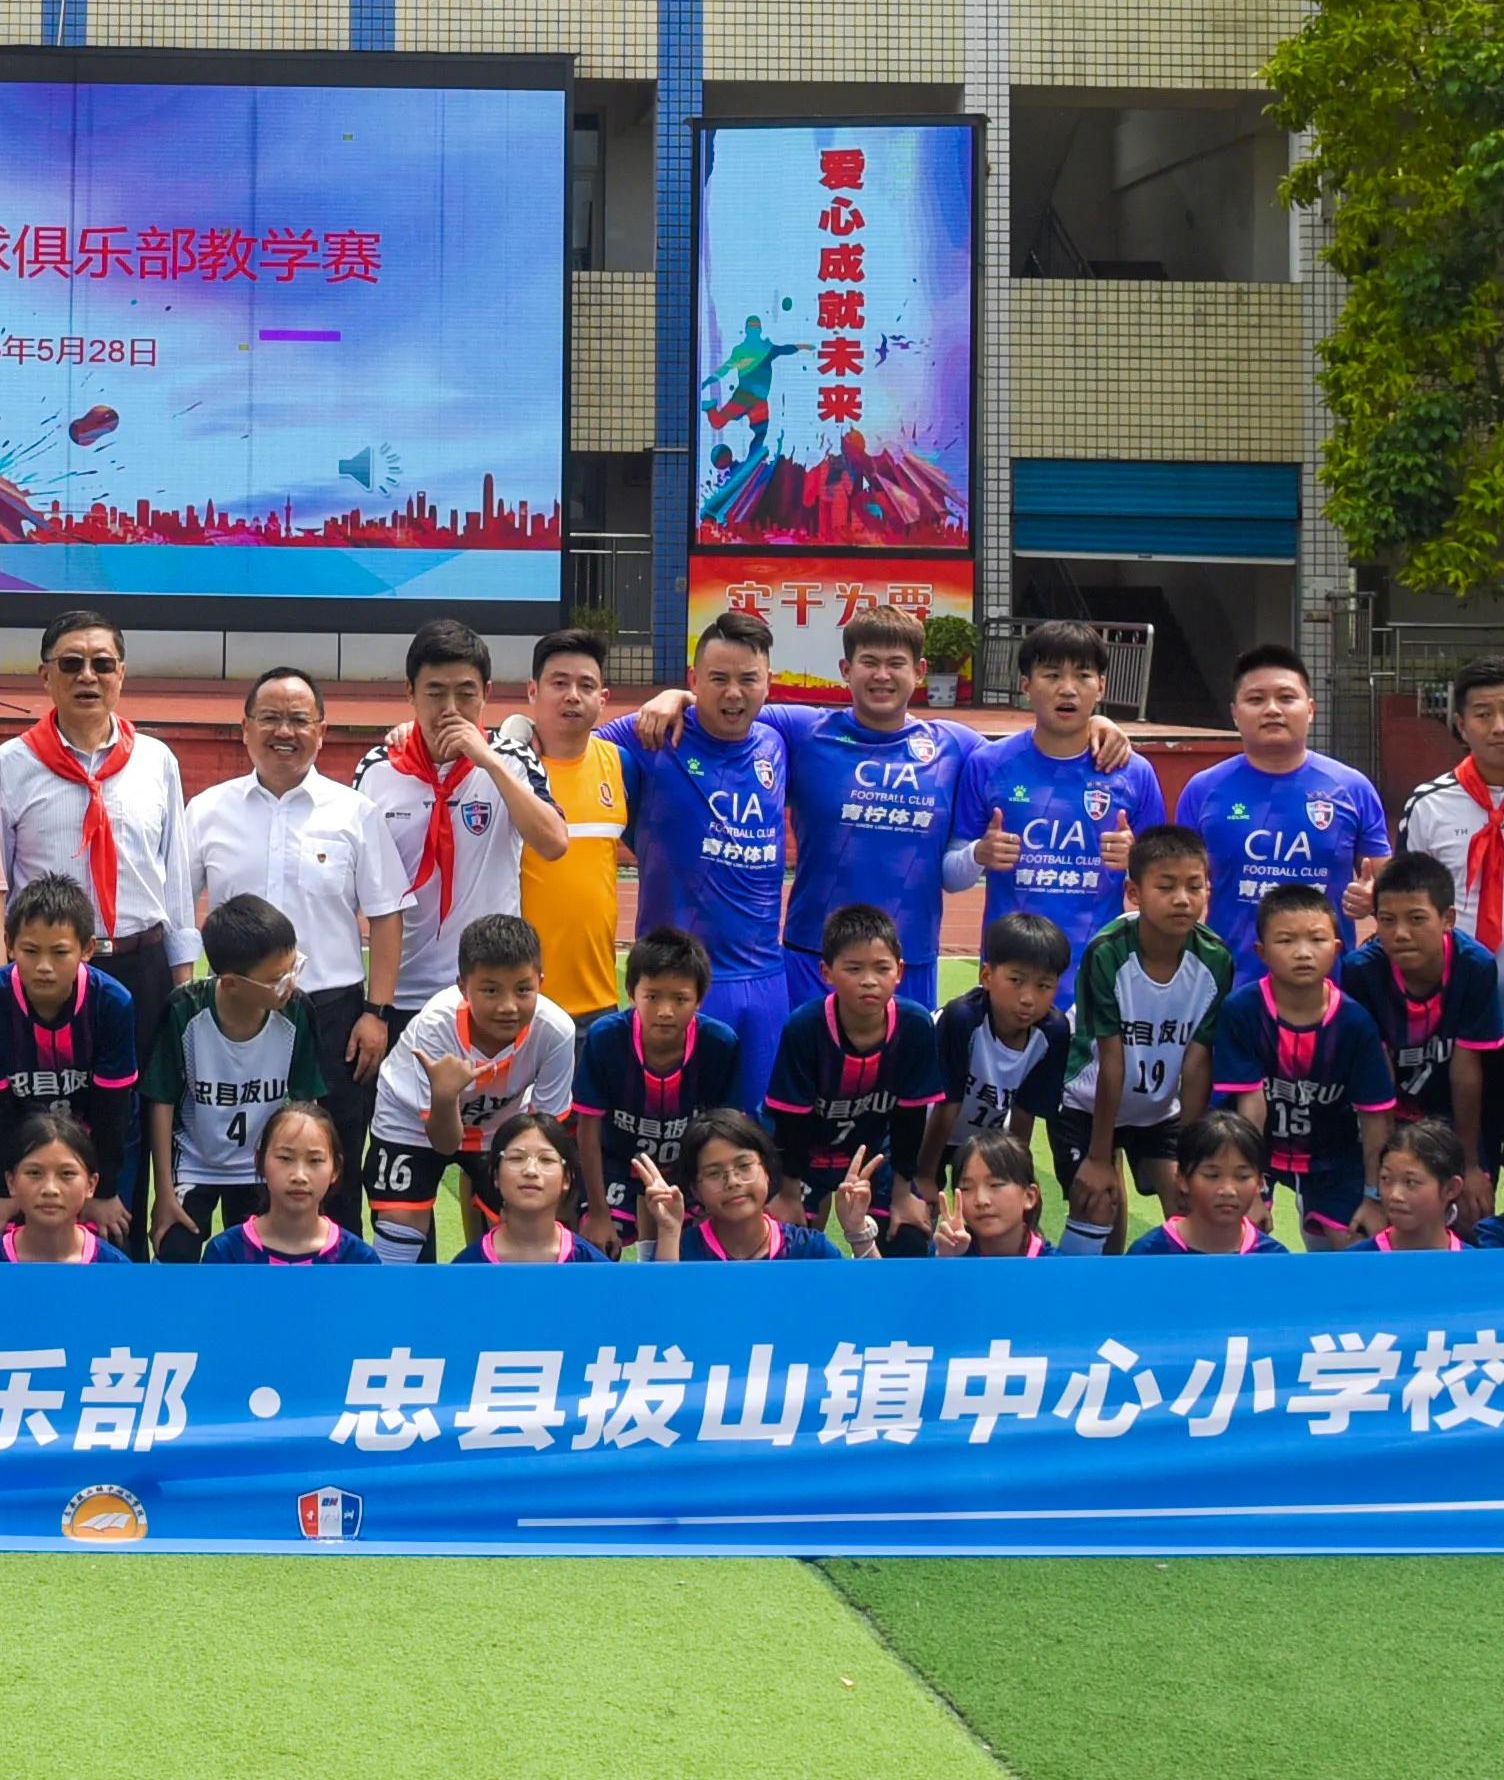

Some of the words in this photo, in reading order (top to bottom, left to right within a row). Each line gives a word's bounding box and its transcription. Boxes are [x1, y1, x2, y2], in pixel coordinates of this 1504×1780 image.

[817, 147, 866, 424] 爱心成就未来
[854, 761, 919, 790] CIA
[708, 790, 764, 824] CIA
[850, 789, 906, 805] FOOTBALL
[908, 795, 935, 807] CLUB
[841, 803, 934, 828] 青柠体育
[756, 827, 776, 839] CLUB
[1022, 818, 1086, 851] CIA
[1244, 829, 1312, 862] CIA
[702, 837, 777, 863] 青柠体育
[1019, 853, 1074, 866] FOOTBALL
[1075, 855, 1101, 867] CLUB
[1015, 868, 1099, 888] 青柠体育
[1243, 864, 1298, 876] FOOTBALL
[1300, 866, 1328, 877] CLUB
[1132, 1059, 1165, 1094] 19
[194, 1078, 286, 1107] 忠县拔山
[226, 1111, 247, 1148] 4
[1271, 1102, 1312, 1138] 15
[374, 1147, 413, 1192] 16
